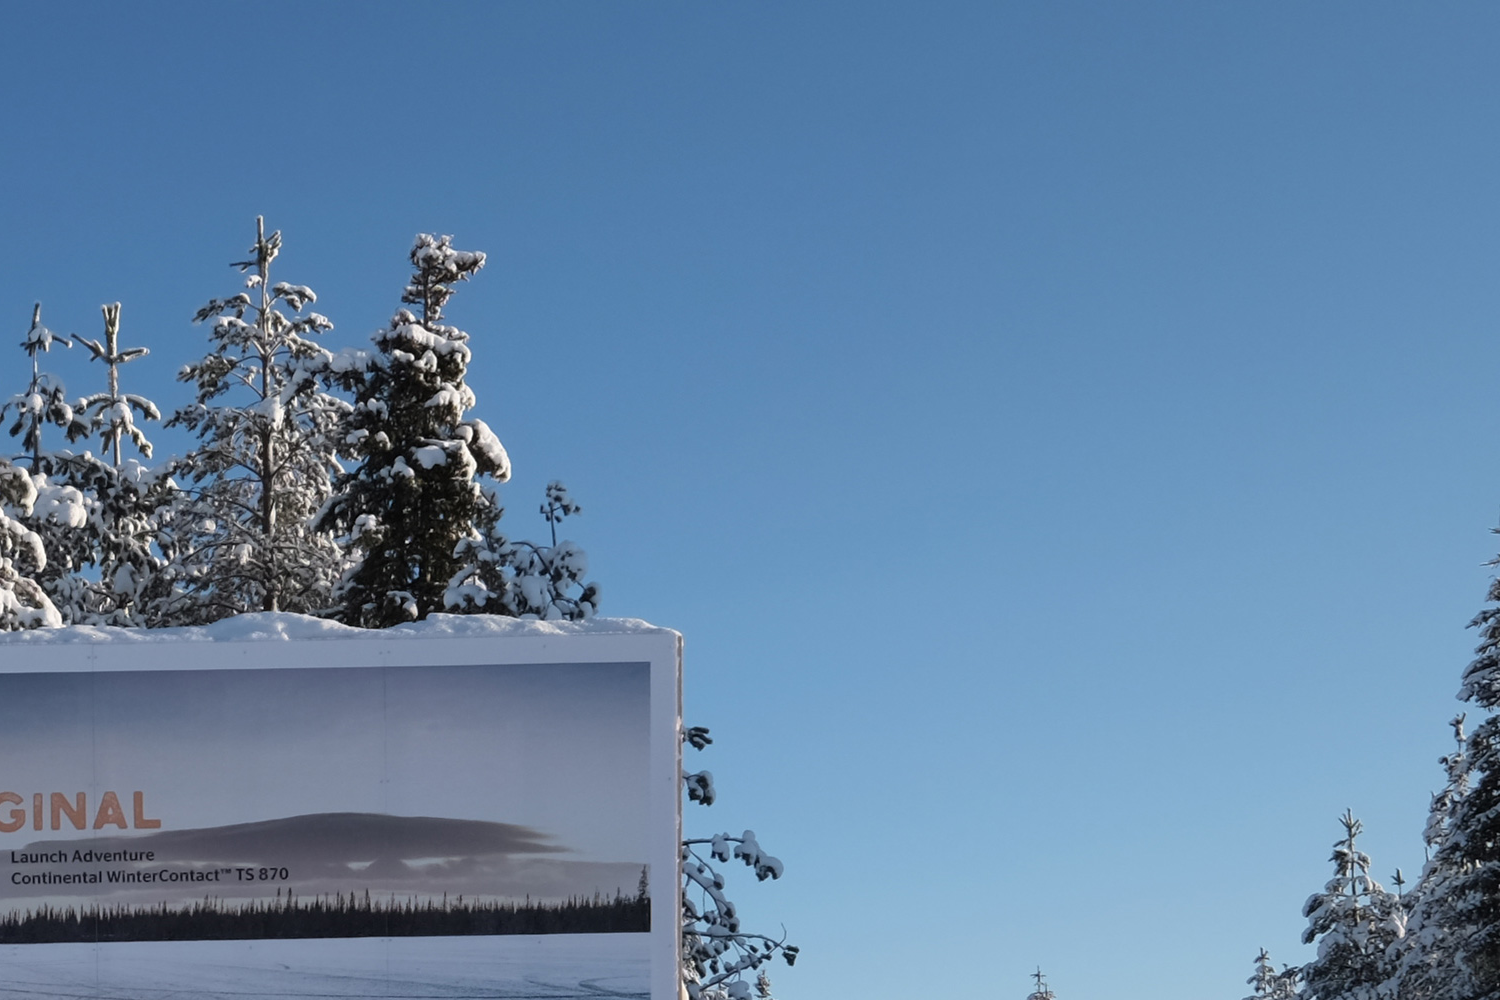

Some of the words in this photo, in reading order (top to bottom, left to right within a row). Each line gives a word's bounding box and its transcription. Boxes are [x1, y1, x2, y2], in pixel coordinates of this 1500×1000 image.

[10, 849, 69, 864] Launch
[71, 848, 155, 863] Adventure
[10, 870, 103, 885] Continental
[236, 868, 255, 881] TS
[258, 867, 289, 881] 870
